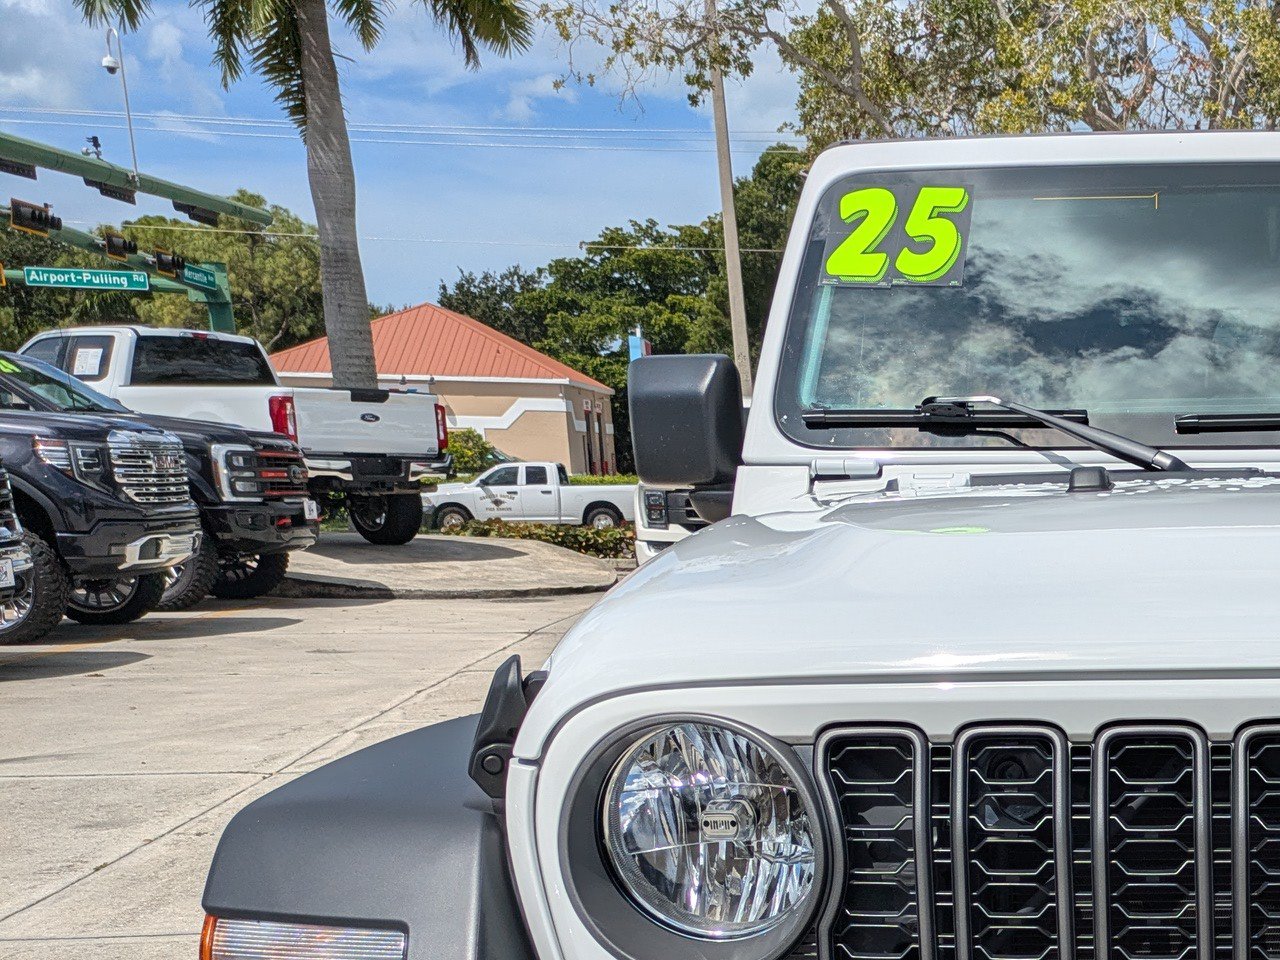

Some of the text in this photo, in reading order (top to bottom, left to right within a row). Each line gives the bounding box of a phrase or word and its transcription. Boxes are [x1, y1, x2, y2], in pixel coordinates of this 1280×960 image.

[825, 186, 969, 282] 25
[29, 270, 144, 287] Airport-Pulling Rd
